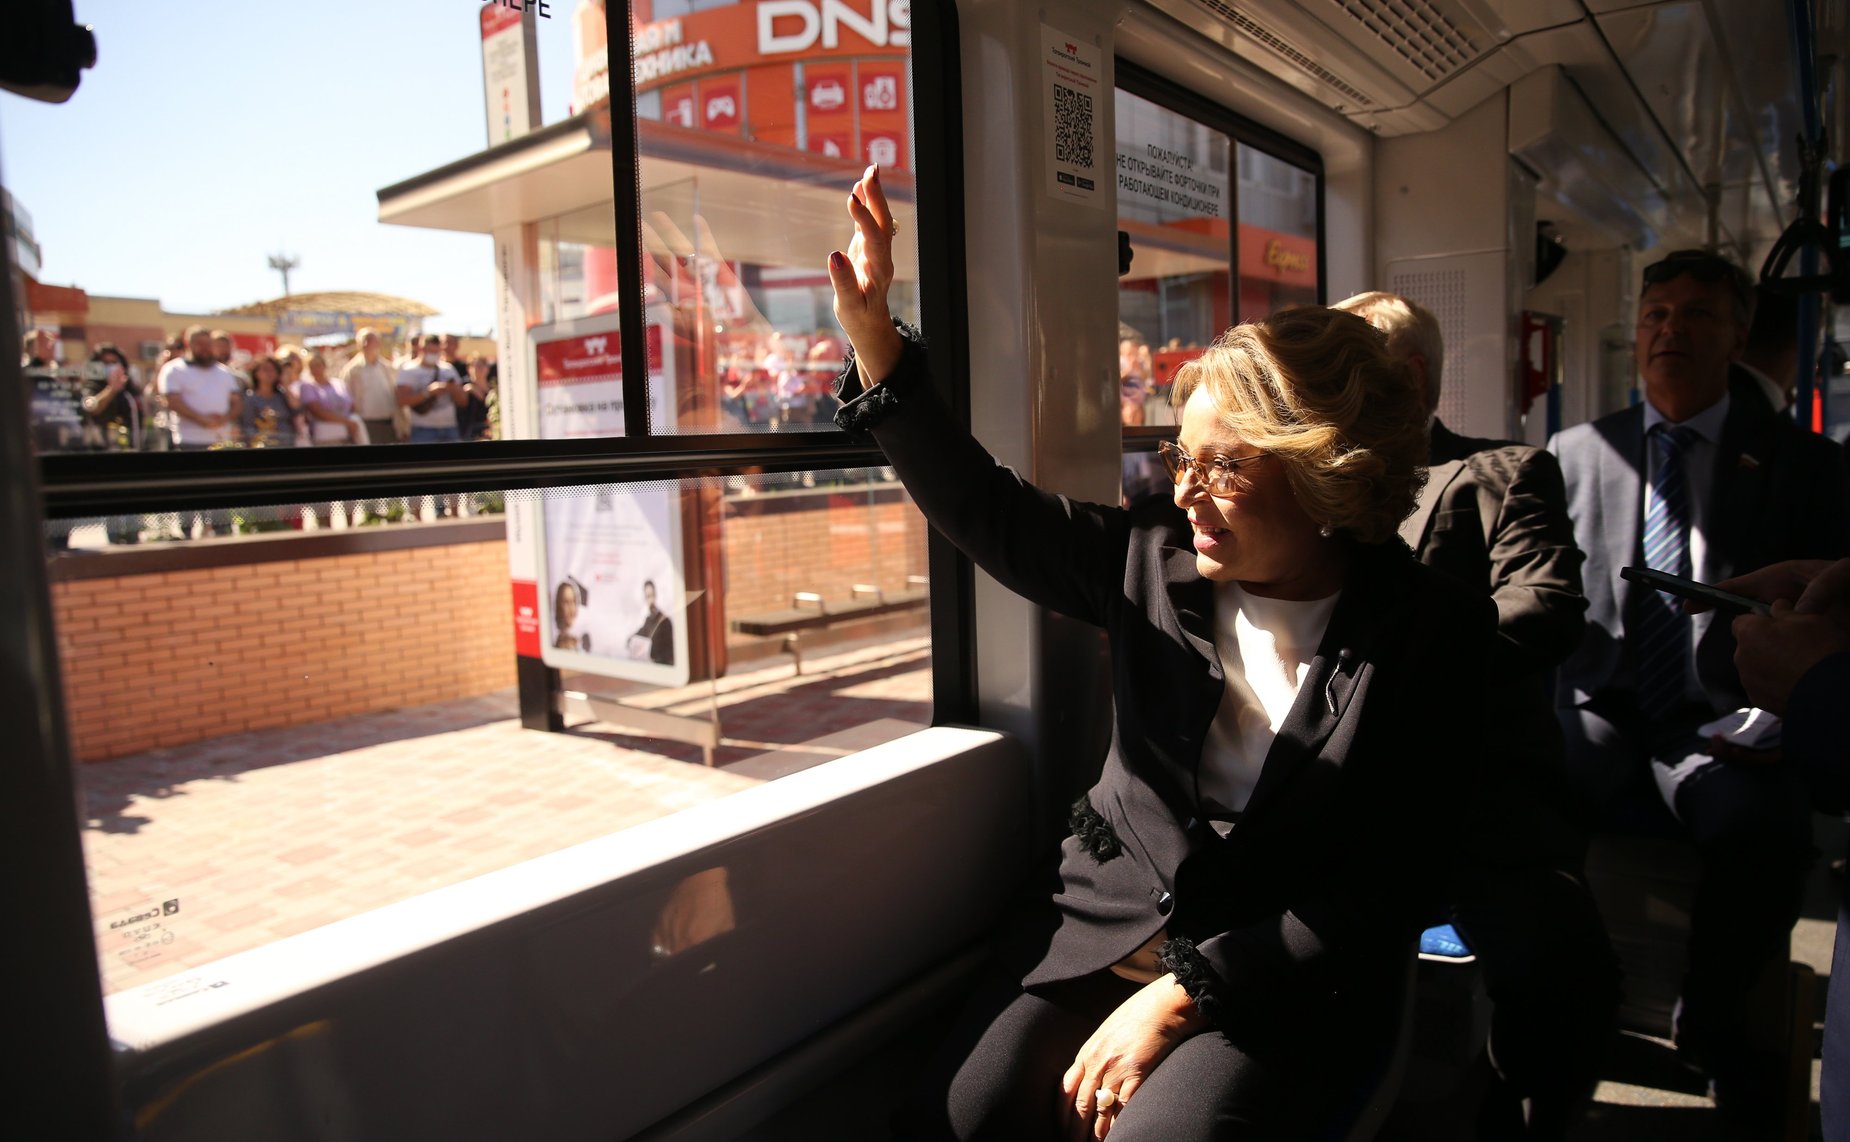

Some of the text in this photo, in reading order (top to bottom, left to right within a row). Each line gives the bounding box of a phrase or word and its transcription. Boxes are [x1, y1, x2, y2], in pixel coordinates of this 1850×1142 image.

[1116, 153, 1220, 199] НЕ ОТКРЫВАЙТЕ ФОРТОЧКИ ПРИ
[1119, 174, 1169, 201] РАБОТАЮЩЕМ
[1171, 190, 1219, 217] КОНДИЦИОНЕРЕ
